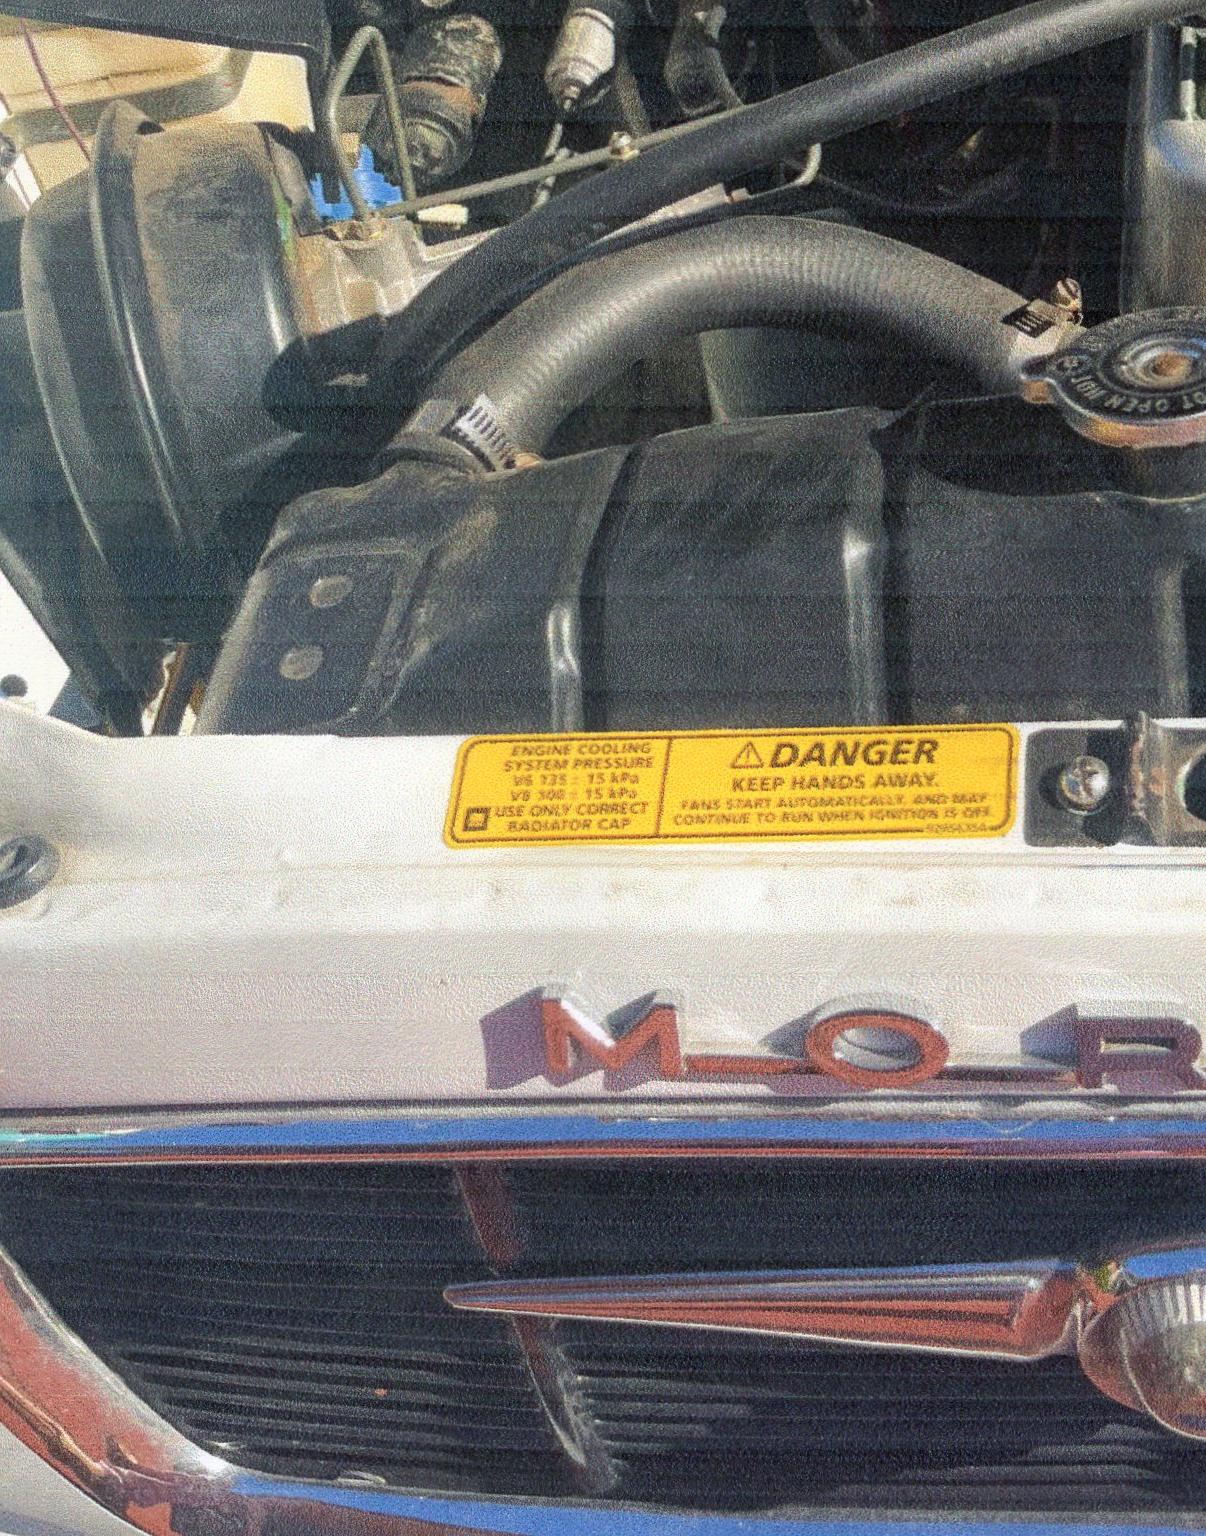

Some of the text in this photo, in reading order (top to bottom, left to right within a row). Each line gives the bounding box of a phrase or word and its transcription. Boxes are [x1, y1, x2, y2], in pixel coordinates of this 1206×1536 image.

[1104, 392, 1170, 414] OPEN
[511, 741, 651, 757] ENGINE COOLING
[768, 739, 939, 768] DANGER
[503, 756, 654, 772] SYSTEM PRESSURE
[587, 772, 605, 784] 15
[610, 772, 640, 784] kPa
[732, 776, 785, 792] KEEP
[790, 774, 866, 790] HANDS
[585, 788, 604, 800] 15
[608, 788, 638, 800] kPa
[726, 798, 772, 809] START
[912, 793, 950, 805] AND
[952, 792, 988, 804] MAY
[495, 801, 649, 817] USE ONLY CORRECT
[674, 813, 750, 826] CONTINUE
[757, 812, 777, 824] TO
[781, 811, 814, 823] RUN
[818, 810, 864, 822] WHEN
[869, 807, 938, 821] IGNITION
[507, 817, 632, 832] RADIATOR CAP
